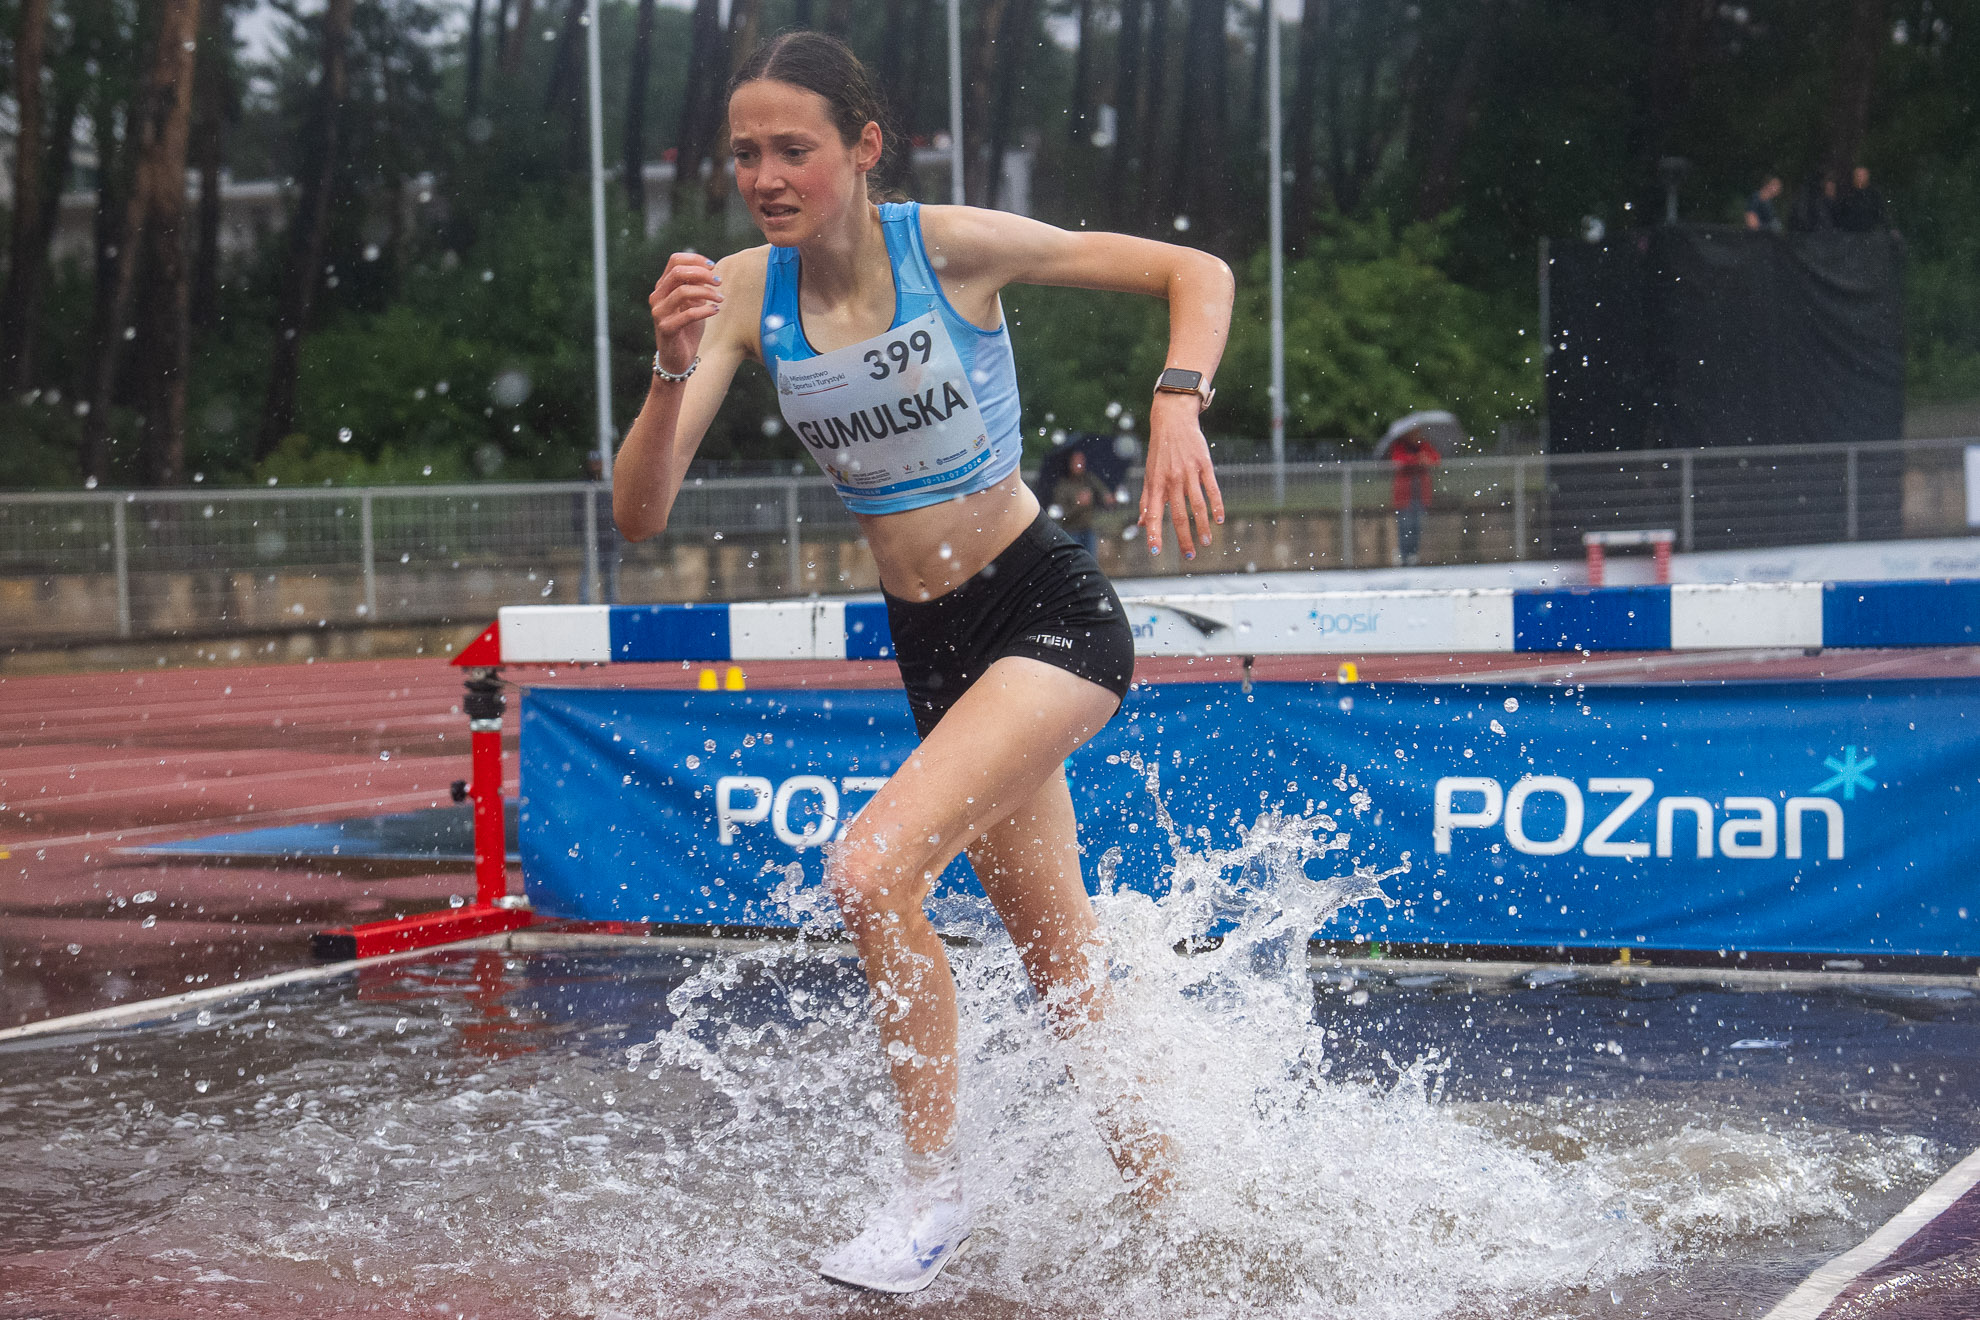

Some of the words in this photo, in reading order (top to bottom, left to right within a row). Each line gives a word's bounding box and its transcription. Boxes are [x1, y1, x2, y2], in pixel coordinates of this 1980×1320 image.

[863, 330, 932, 381] 399
[789, 370, 829, 382] Ministerstwo
[792, 381, 813, 390] Sportu
[815, 373, 846, 386] Turystyki
[797, 381, 969, 450] GUMULSKA
[922, 457, 982, 485] 10-13.07.202
[716, 775, 891, 847] POZ
